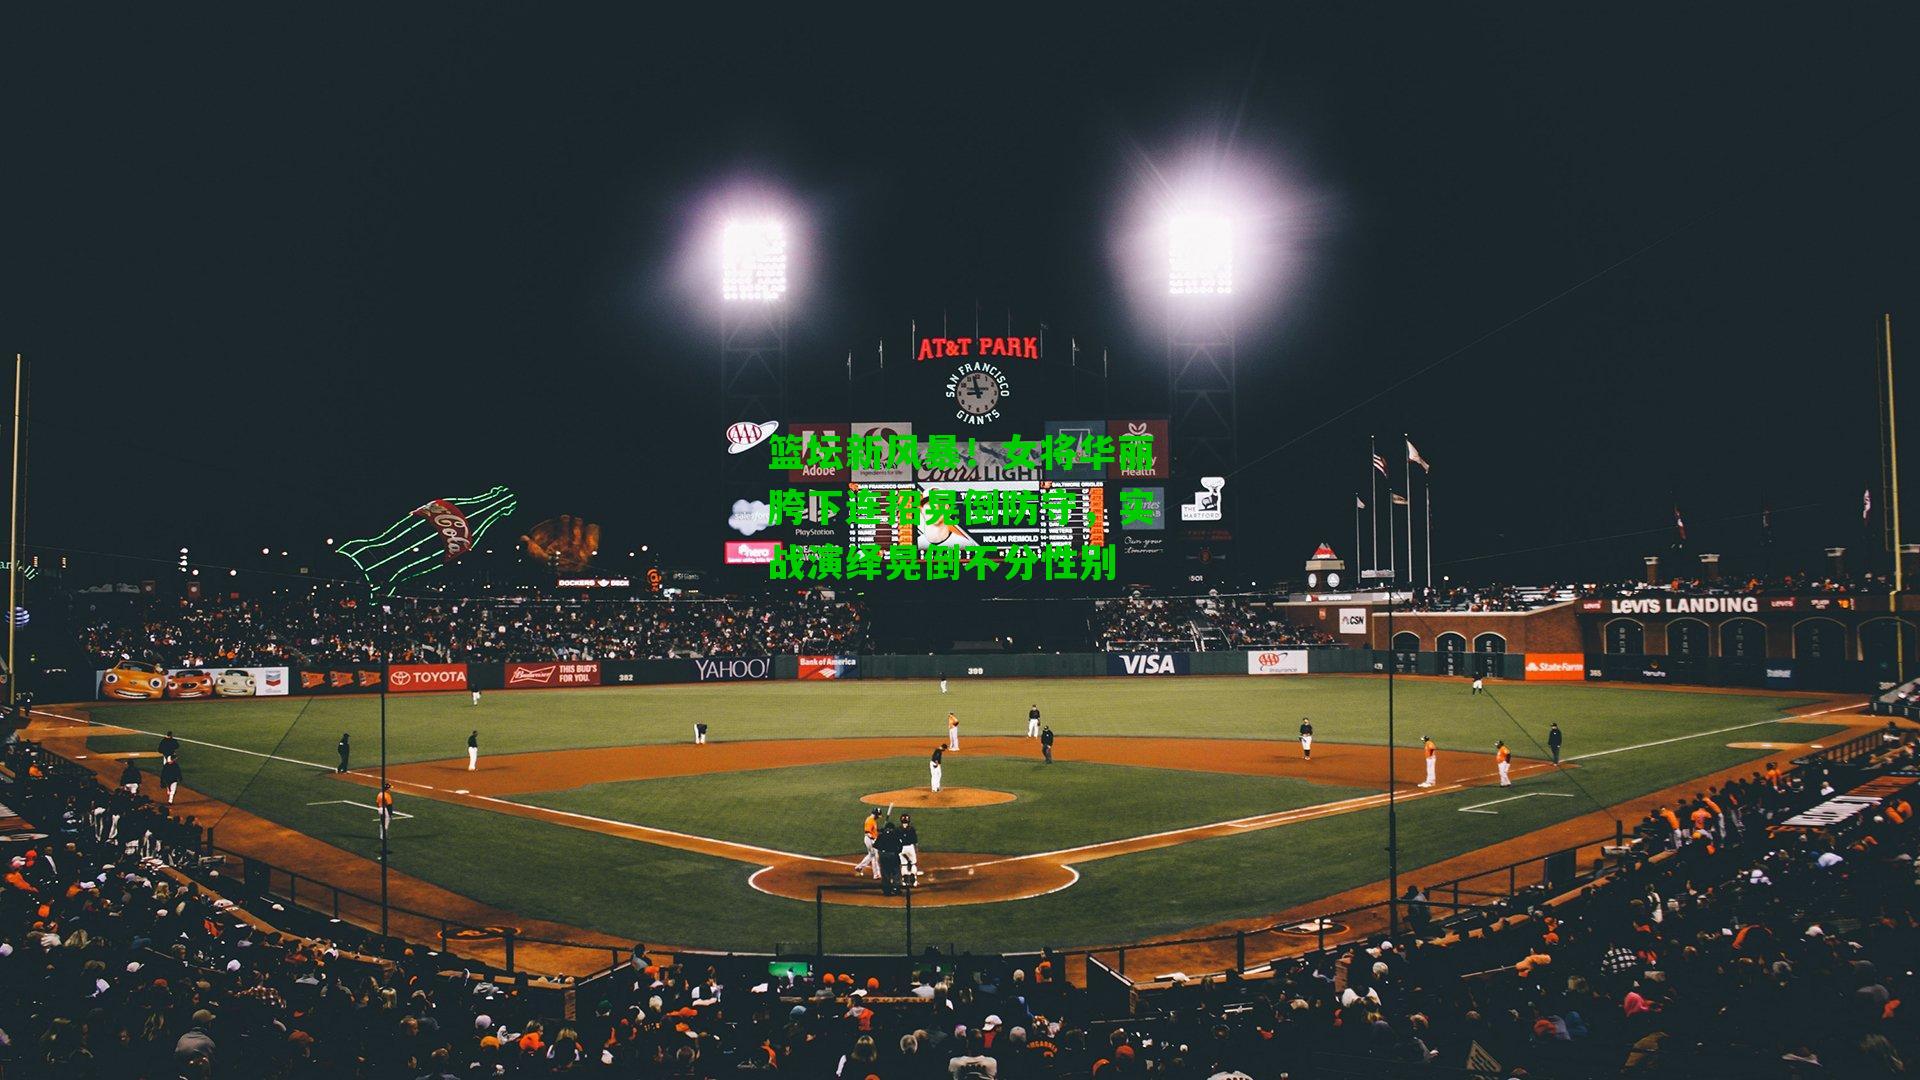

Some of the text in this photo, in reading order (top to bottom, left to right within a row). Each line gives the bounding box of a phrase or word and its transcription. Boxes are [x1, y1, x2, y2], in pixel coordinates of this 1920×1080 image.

[918, 336, 1038, 360] AT&T PARK
[945, 361, 1010, 398] SAN FRANCISCO
[956, 409, 1001, 425] GIANTS
[1121, 467, 1156, 476] Health
[795, 529, 835, 537] PlayStation
[558, 579, 596, 587] DOCKERS
[1666, 597, 1759, 613] LANDING
[1350, 616, 1365, 625] CSN
[800, 658, 857, 666] Bank of America
[1119, 655, 1176, 674] VISA
[559, 664, 598, 673] THIS BUD'S
[695, 658, 770, 681] YAHOO!
[413, 671, 467, 683] TOYOTA
[559, 674, 573, 682] FOR
